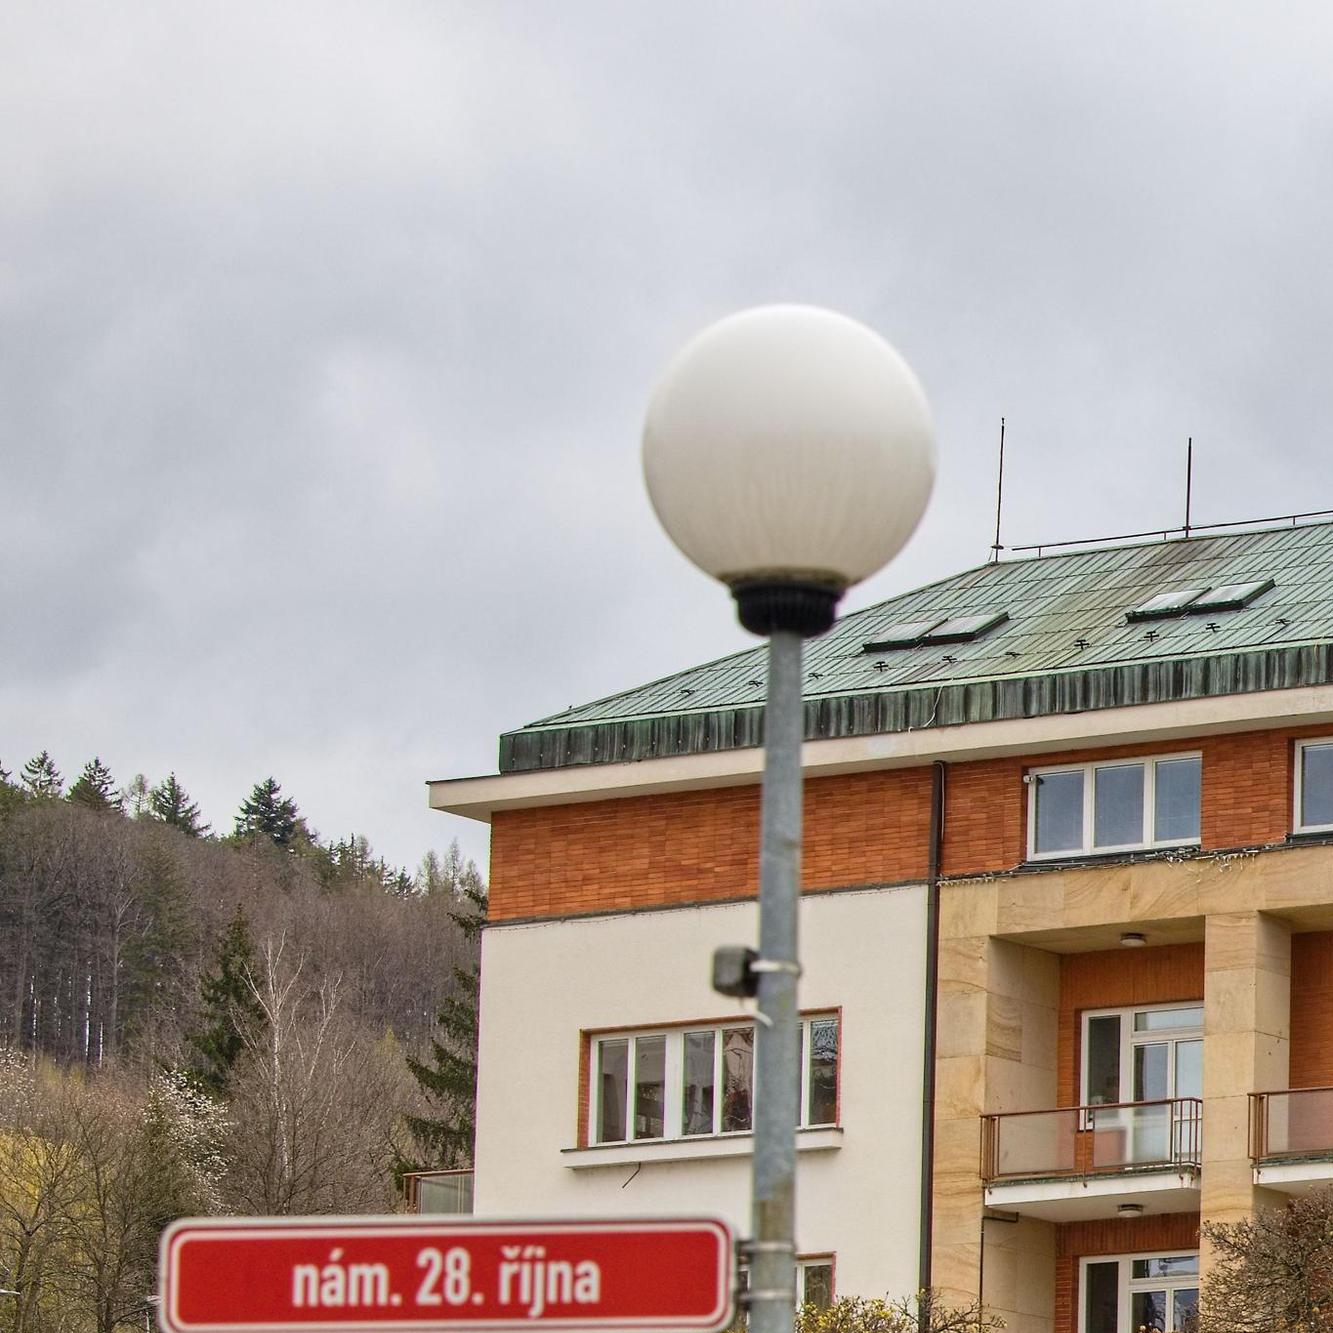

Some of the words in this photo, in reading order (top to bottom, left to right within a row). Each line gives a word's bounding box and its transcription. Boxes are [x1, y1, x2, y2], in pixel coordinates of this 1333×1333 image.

[292, 1247, 402, 1308] nám.
[415, 1246, 486, 1306] 28.
[498, 1245, 602, 1318] října
